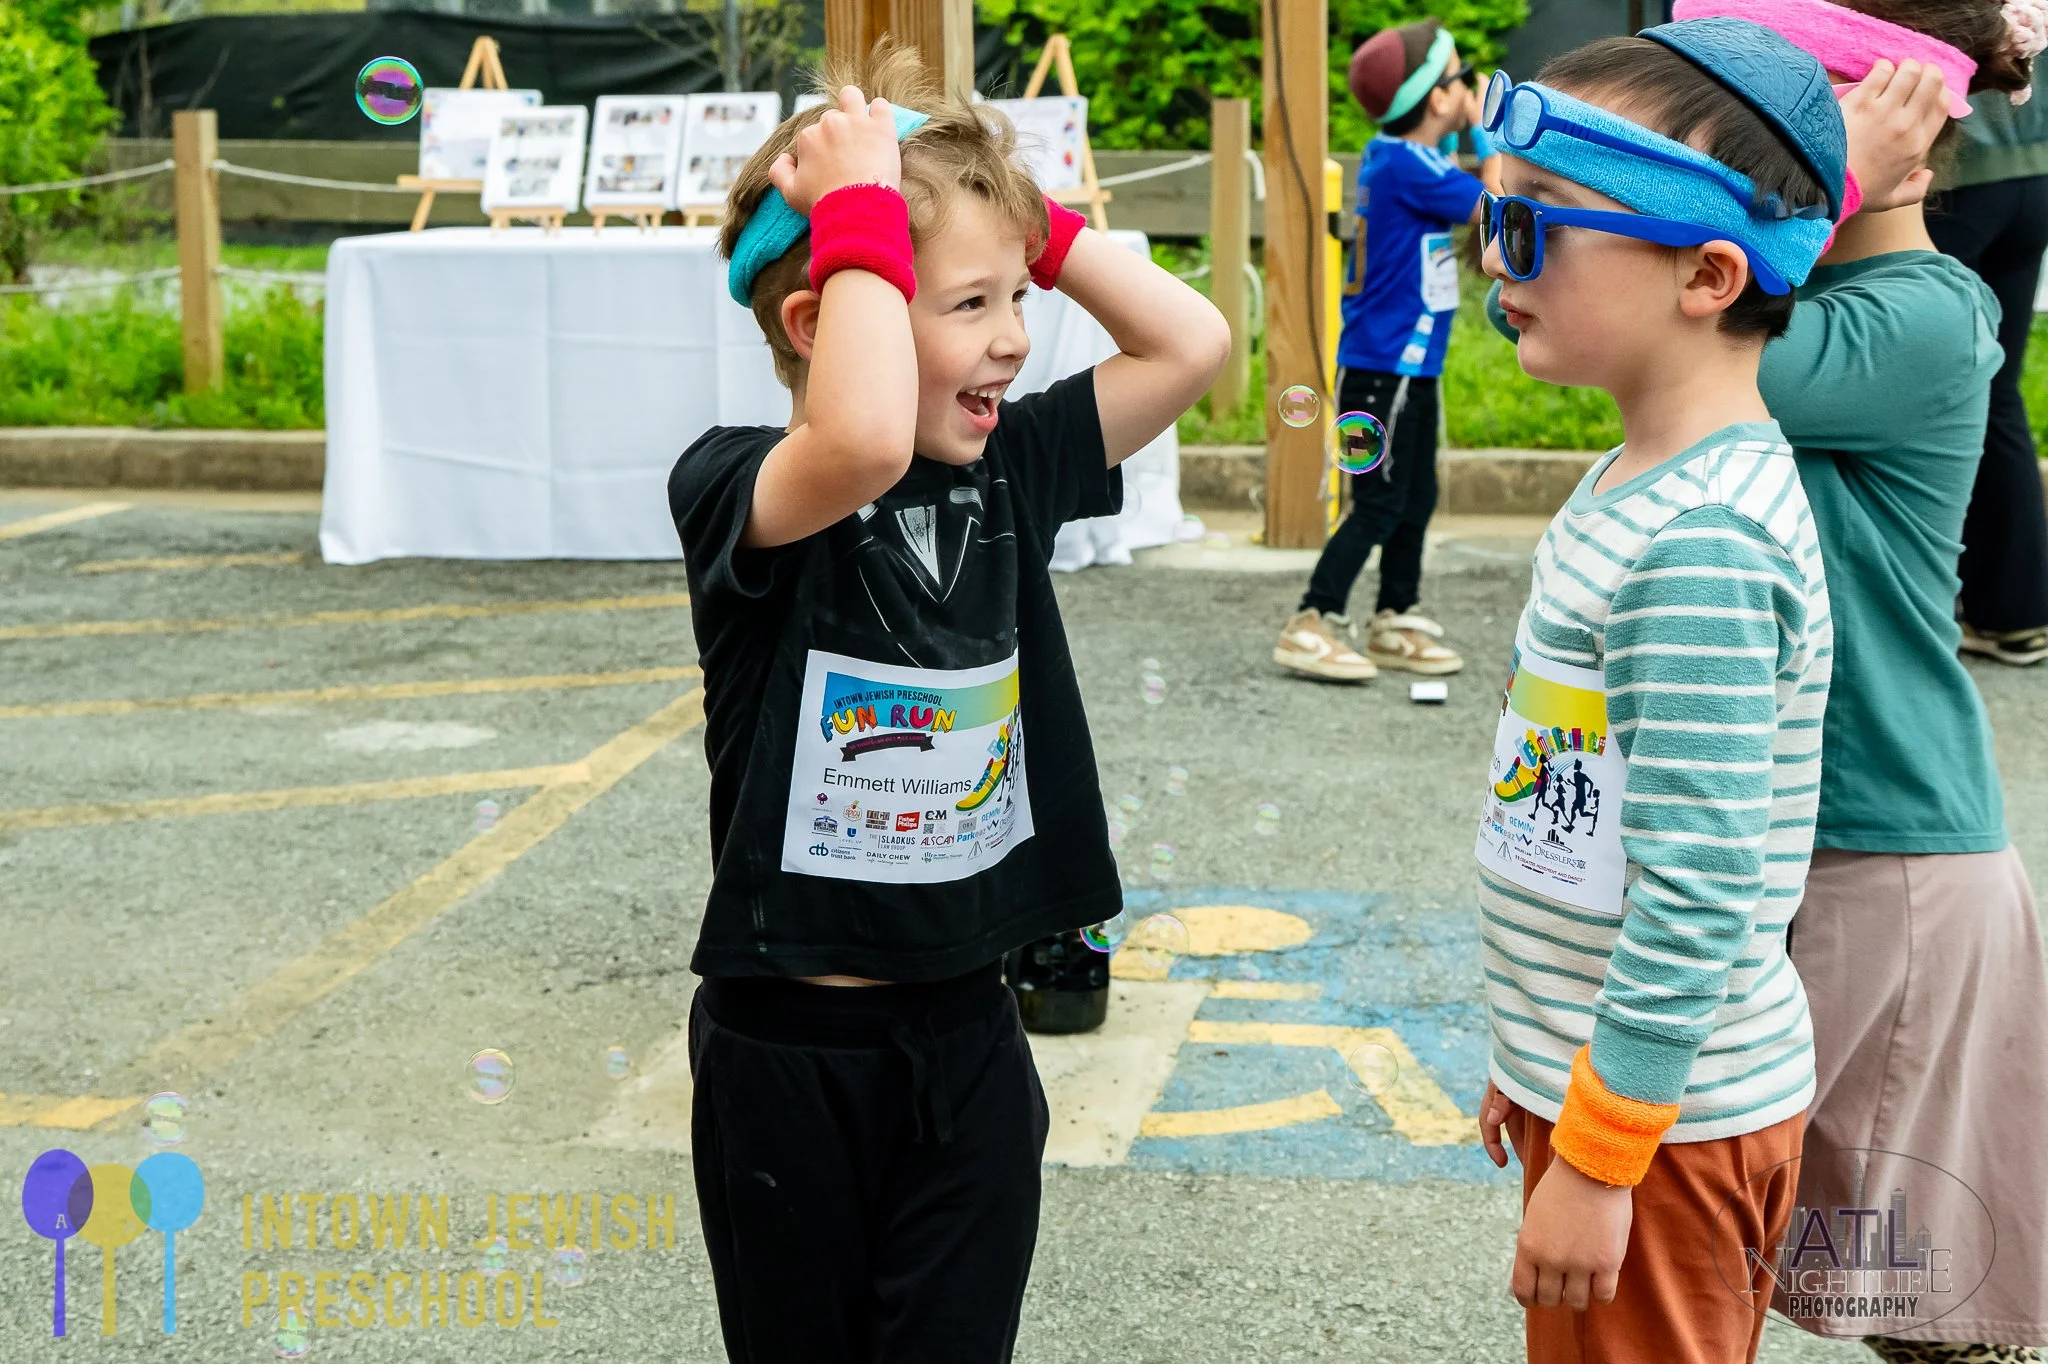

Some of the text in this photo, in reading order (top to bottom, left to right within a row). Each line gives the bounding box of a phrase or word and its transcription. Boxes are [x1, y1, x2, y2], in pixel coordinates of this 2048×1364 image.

[833, 689, 943, 709] INTOWN JEWISH PRESCHOOL
[820, 704, 878, 743] FUN
[890, 704, 957, 733] RUN
[823, 767, 972, 796] Emmett Williams
[898, 815, 916, 823] Fisher
[881, 835, 916, 845] SLADKUS
[920, 835, 955, 846] ALSCAN
[809, 842, 829, 856] ctb
[866, 851, 887, 859] DAILY
